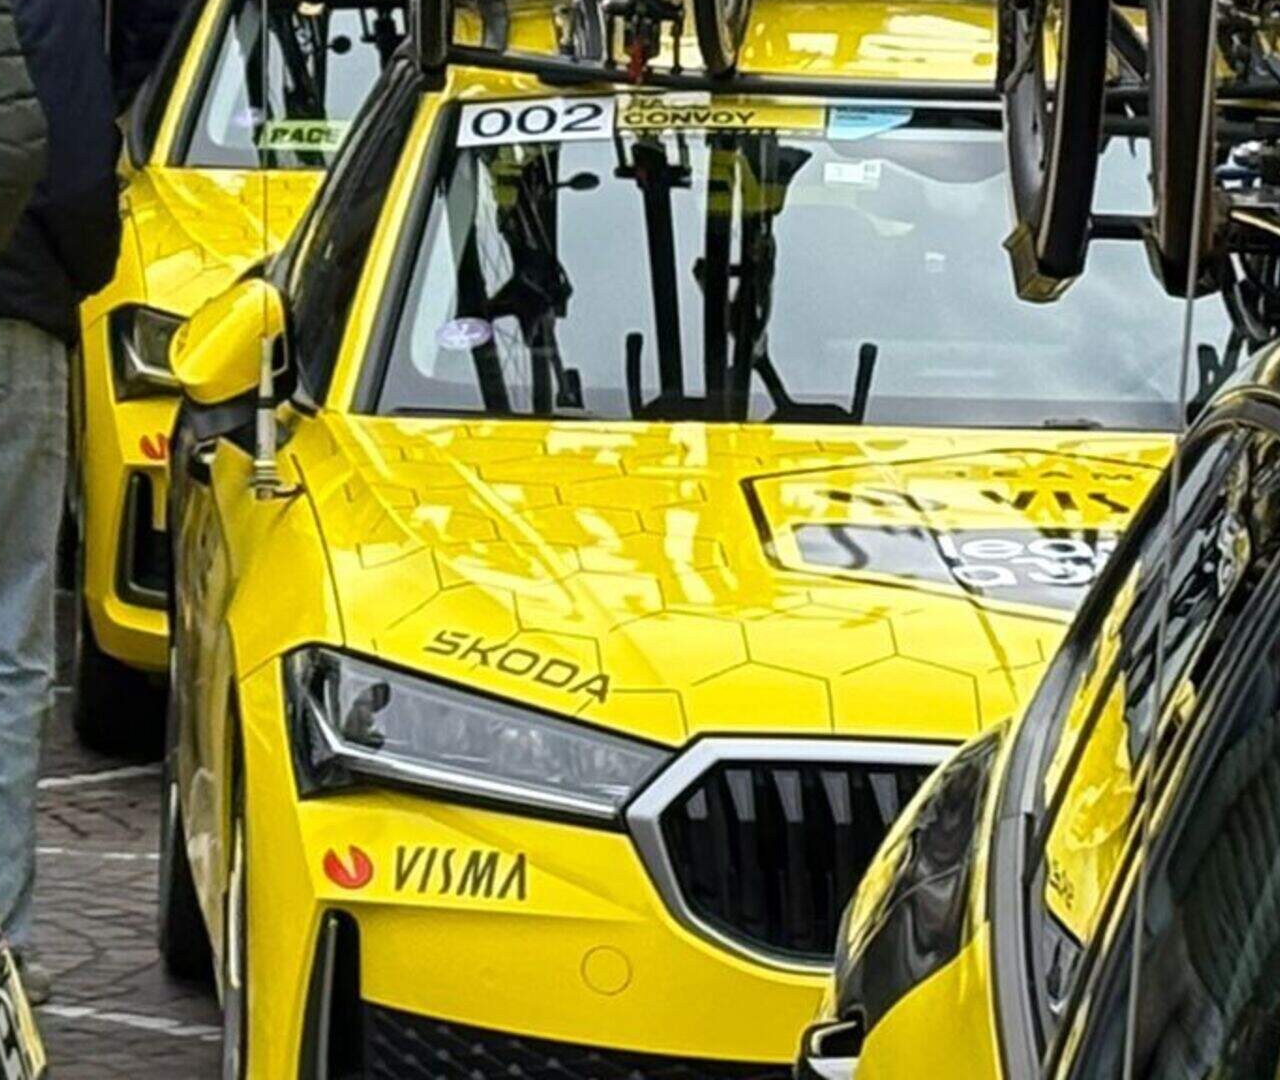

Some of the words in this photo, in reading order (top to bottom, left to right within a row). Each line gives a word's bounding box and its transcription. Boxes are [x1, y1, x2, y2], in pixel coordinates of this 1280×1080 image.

[472, 103, 603, 139] 002
[624, 110, 755, 125] CONVOY
[394, 845, 527, 901] VISMA
